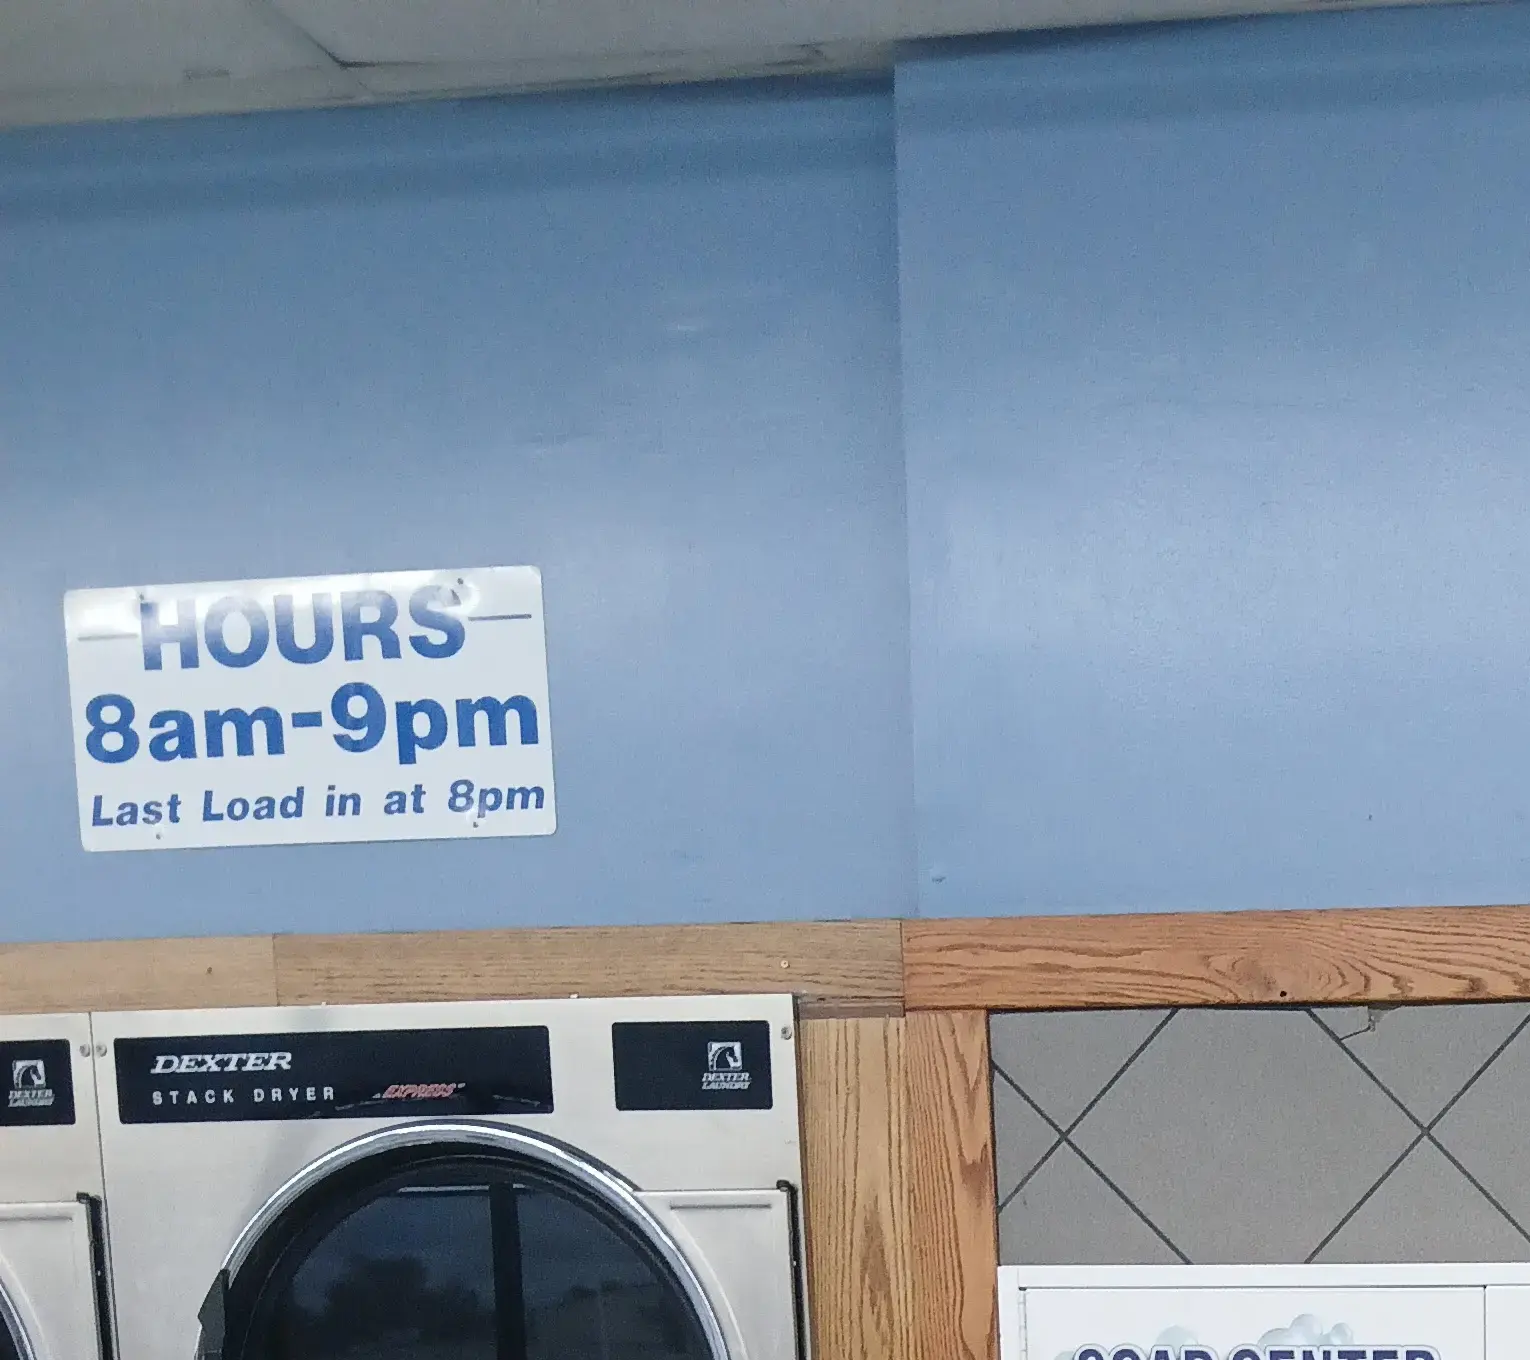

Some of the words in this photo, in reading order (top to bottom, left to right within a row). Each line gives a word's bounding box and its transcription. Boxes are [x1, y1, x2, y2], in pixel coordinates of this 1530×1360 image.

[139, 584, 467, 672] HOURS
[84, 682, 540, 765] 8am-9pm
[91, 791, 182, 828] Last
[201, 786, 305, 823] Load
[325, 784, 362, 817] in
[383, 783, 427, 816] at
[447, 778, 546, 819] 8pm
[150, 1051, 293, 1075] DEXTER
[151, 1088, 235, 1105] STACK
[253, 1085, 335, 1103] DRYER
